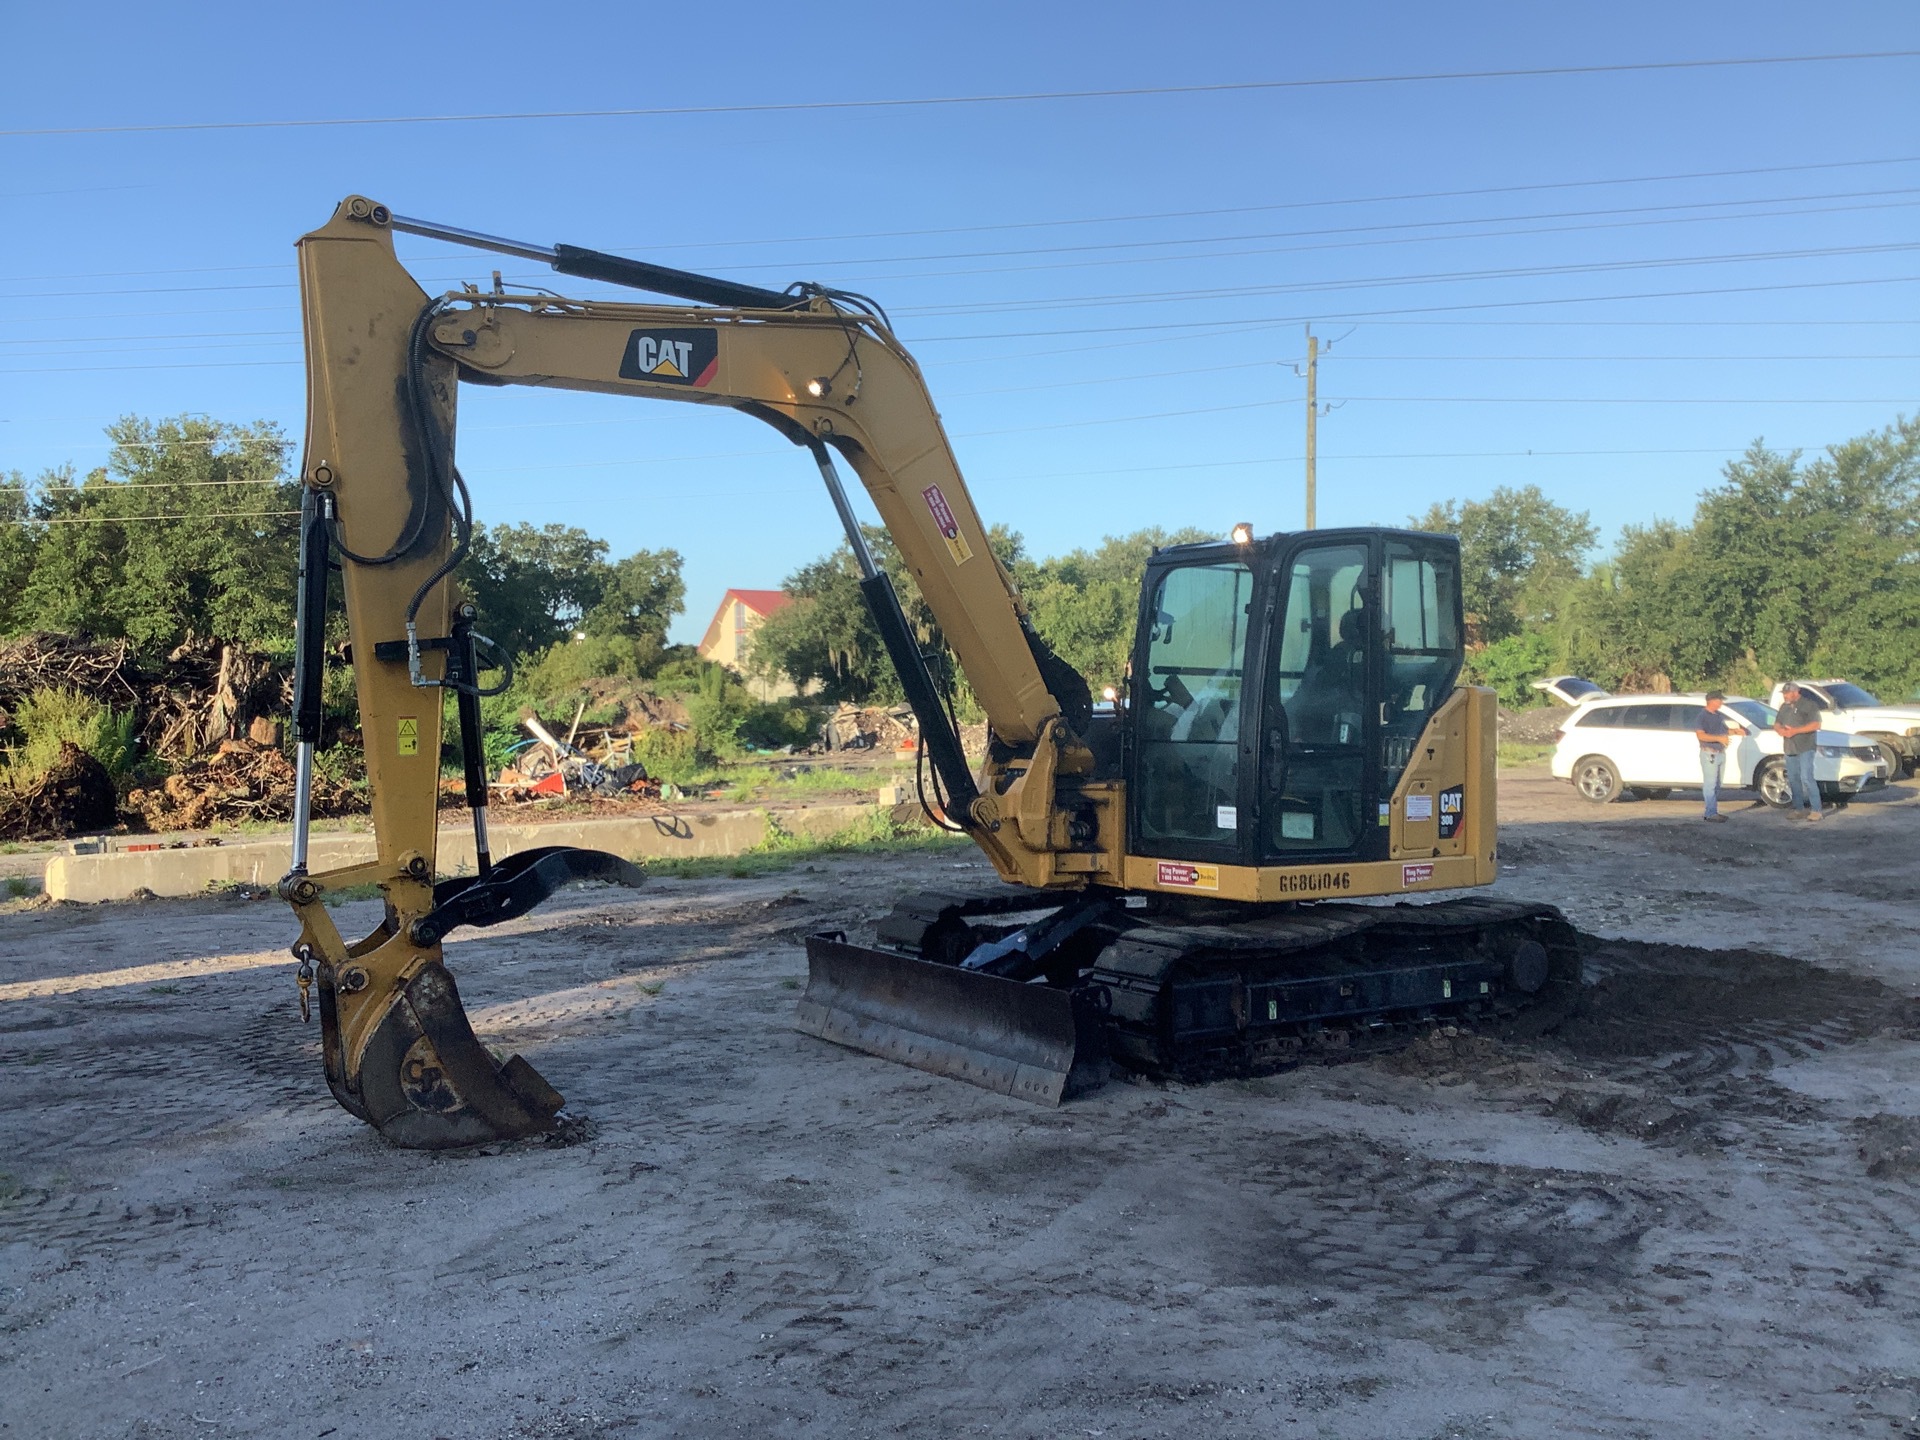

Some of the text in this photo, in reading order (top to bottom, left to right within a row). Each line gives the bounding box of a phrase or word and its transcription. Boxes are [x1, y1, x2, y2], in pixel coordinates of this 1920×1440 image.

[638, 336, 693, 378] CAT
[1441, 793, 1462, 813] CAT
[1161, 866, 1188, 876] Ring Power
